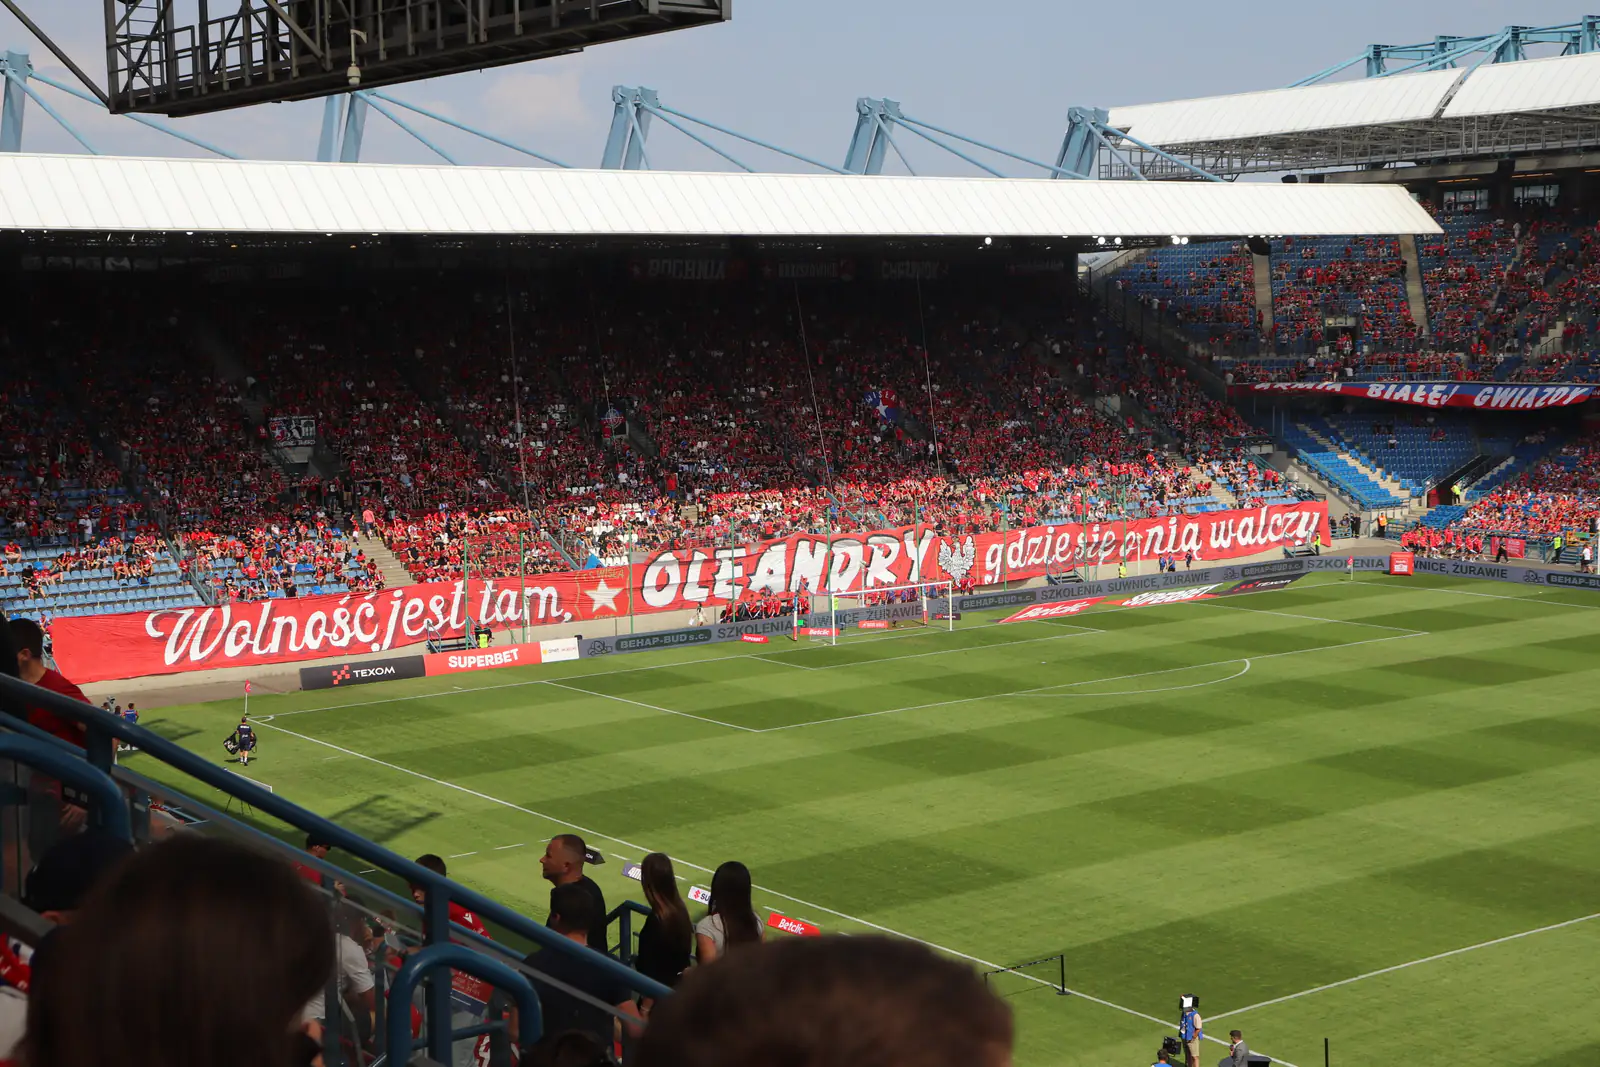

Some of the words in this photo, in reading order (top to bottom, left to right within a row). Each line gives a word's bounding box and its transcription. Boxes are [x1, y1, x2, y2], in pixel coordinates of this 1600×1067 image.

[1366, 383, 1460, 406] BIAŁEJ
[1473, 386, 1590, 409] GWIAZDY
[984, 526, 1072, 585] gdzie
[1142, 516, 1202, 561] nią
[1210, 505, 1321, 549] walczy
[641, 523, 935, 608] OLEANDRY
[1244, 563, 1288, 576] BEHAP-BUD
[1452, 561, 1508, 579] ŻURAWIE
[963, 595, 1016, 609] BEHAP-BUD
[1041, 584, 1103, 600] SZKOLENIA
[1107, 577, 1160, 592] SUWNICE,
[1162, 571, 1211, 586] ŻURAWIE
[145, 591, 379, 666] Wolność
[371, 580, 466, 652] jest
[479, 580, 573, 625] tam,
[620, 635, 687, 649] BEHAP-BUD
[688, 634, 708, 642] s.c.
[717, 621, 794, 640] SZKOLENIA
[448, 648, 519, 669] SUPERBET
[353, 666, 396, 679] TEXOM
[778, 918, 805, 935] Betclic
